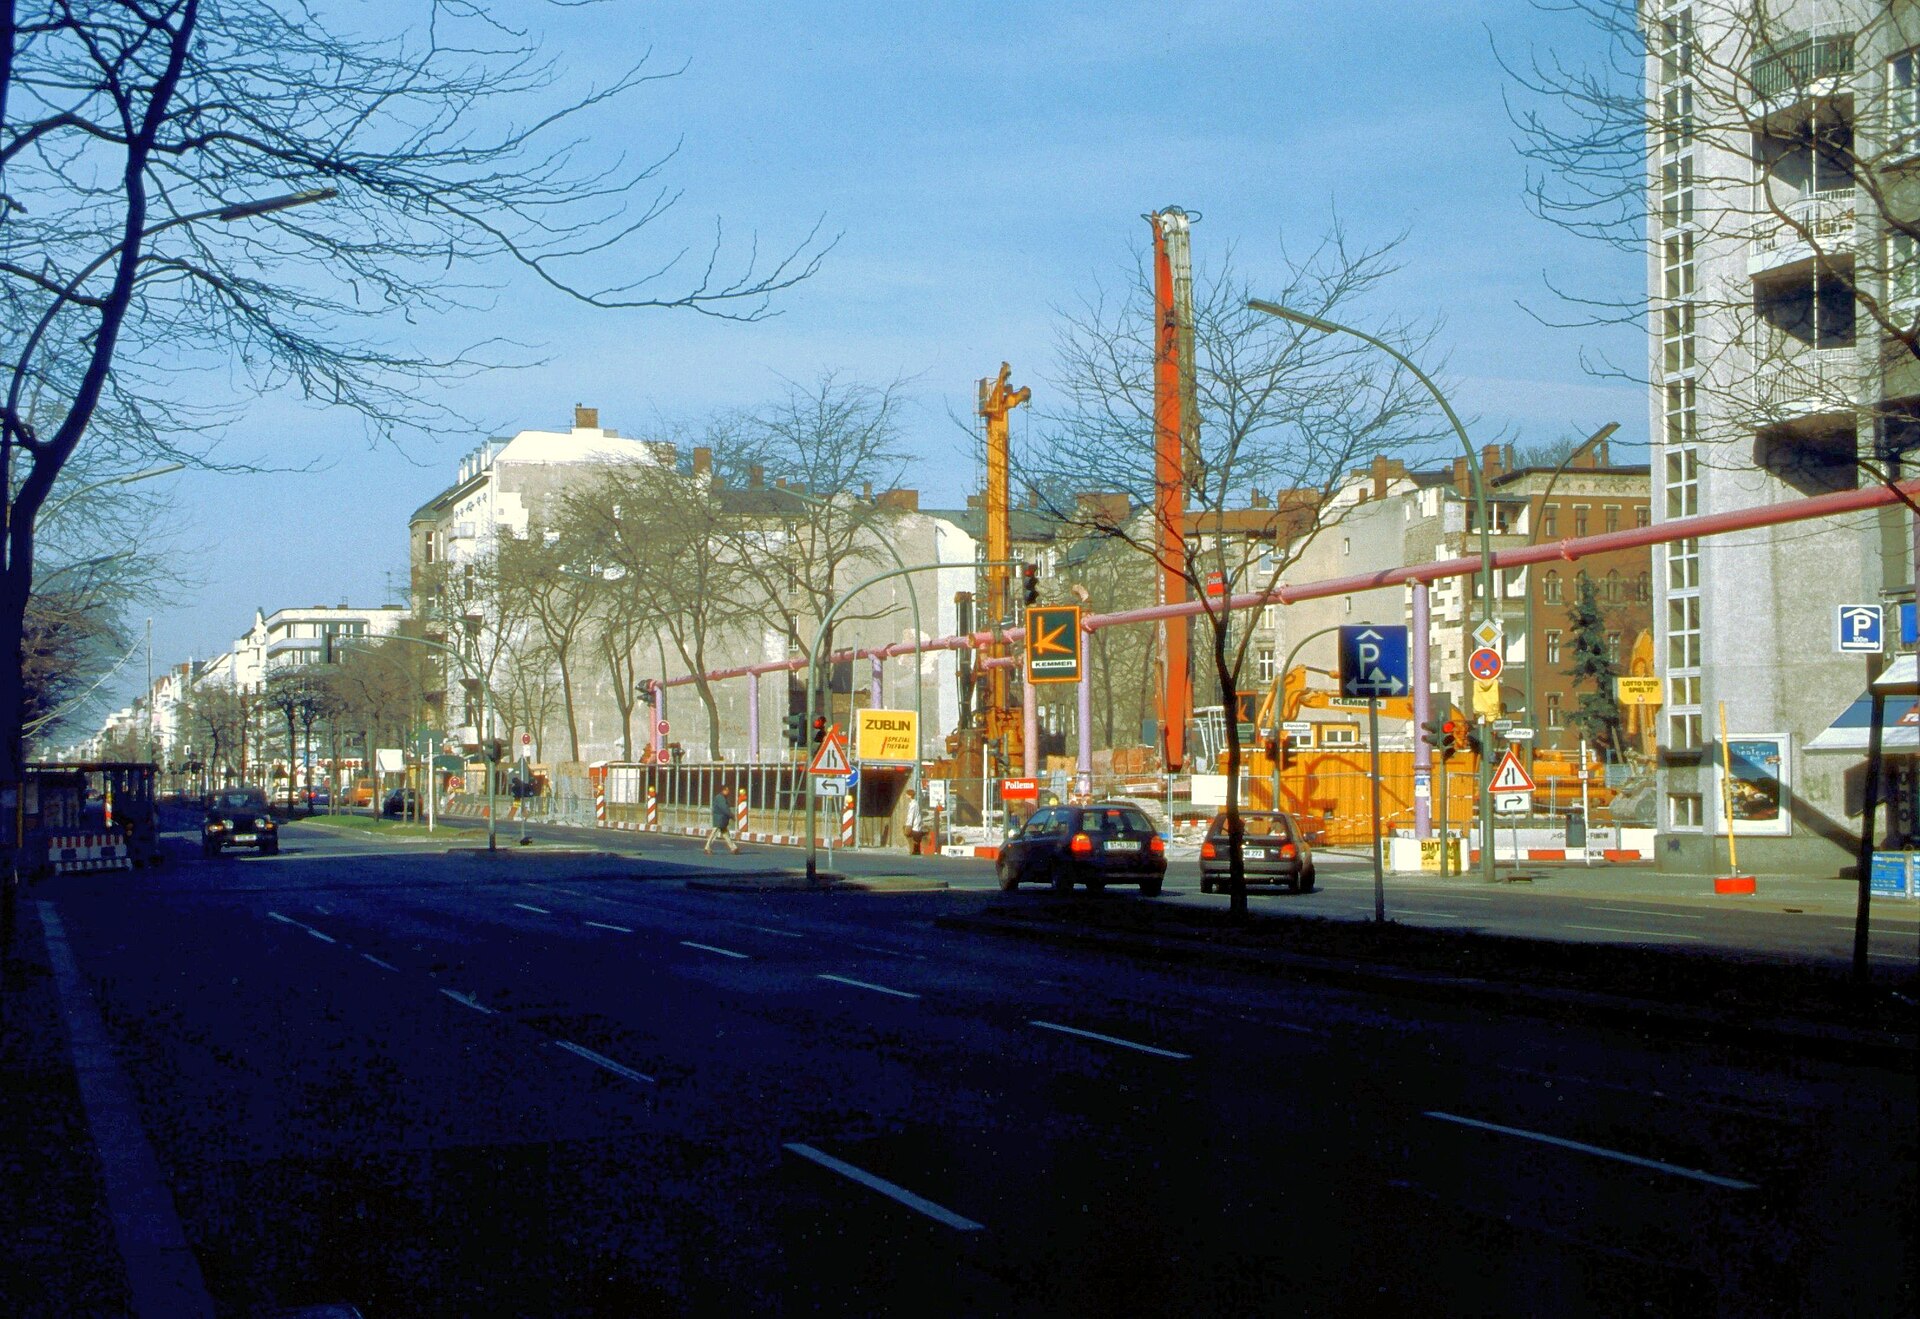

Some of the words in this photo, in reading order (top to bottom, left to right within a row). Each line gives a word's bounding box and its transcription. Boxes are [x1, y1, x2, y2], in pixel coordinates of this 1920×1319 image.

[1853, 615, 1871, 636] P
[1359, 643, 1379, 679] P
[1333, 699, 1382, 707] KEMMR
[1421, 842, 1440, 851] BMT
